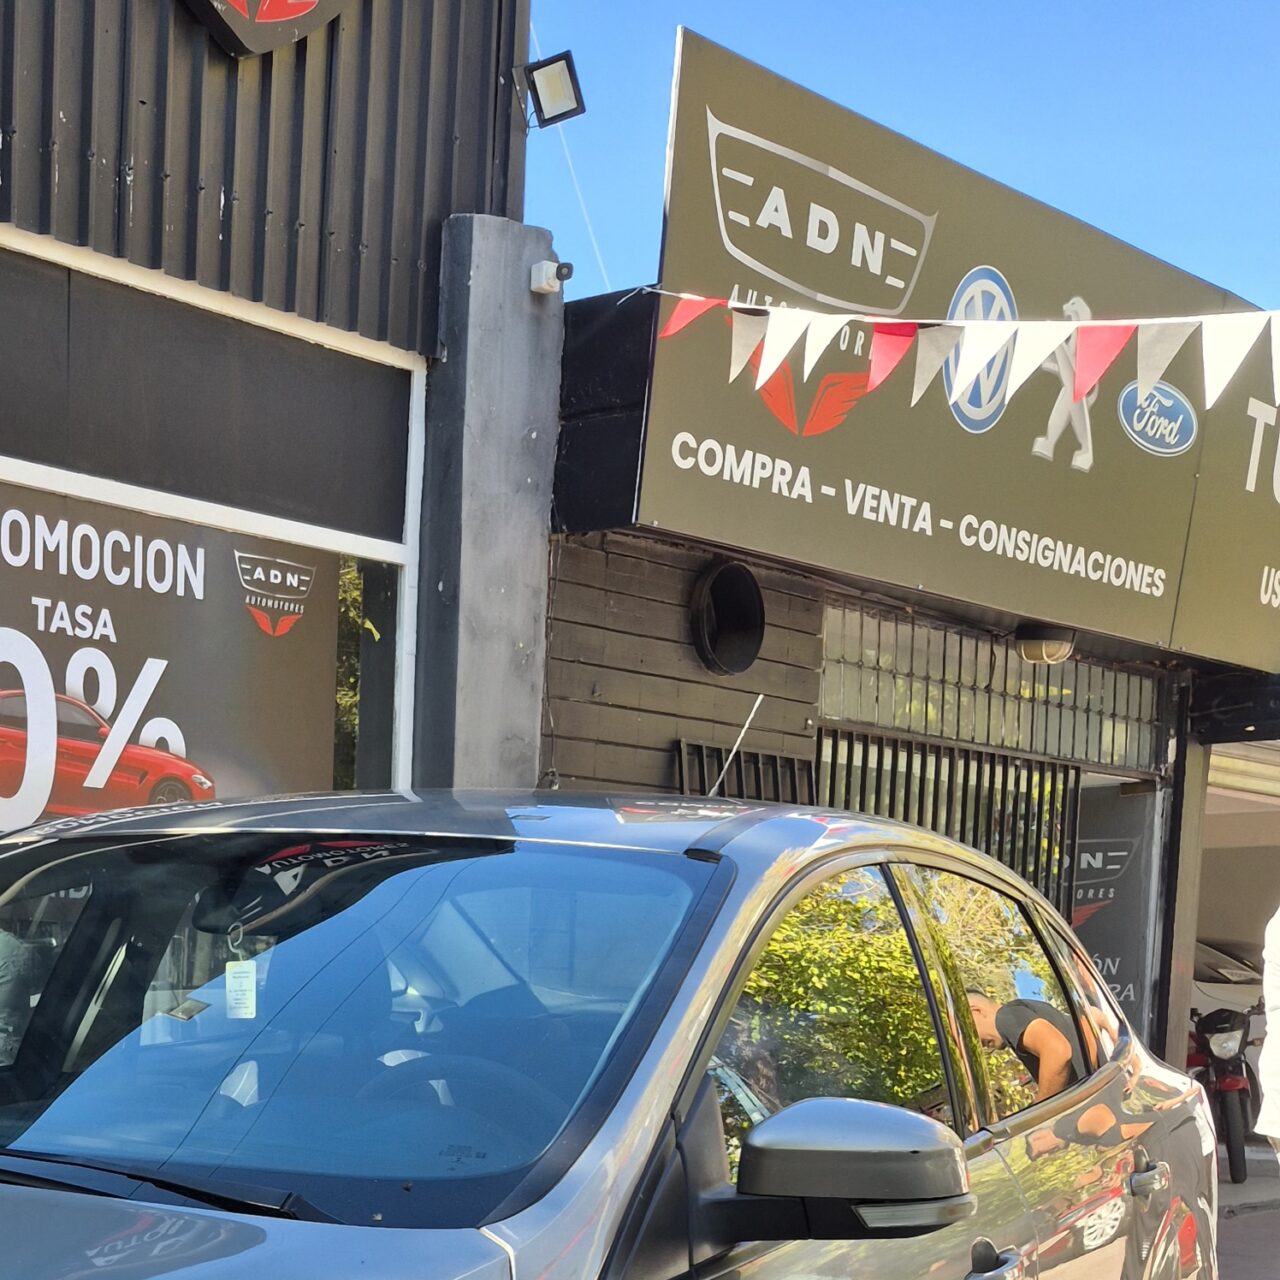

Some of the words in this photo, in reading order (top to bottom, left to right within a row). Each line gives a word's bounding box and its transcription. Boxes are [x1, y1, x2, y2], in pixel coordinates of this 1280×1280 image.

[756, 187, 884, 276] ADN
[1132, 388, 1184, 446] Ford
[671, 431, 813, 504] COMPRA
[844, 478, 933, 537] VENTA
[959, 514, 1167, 598] CONSIGNACIONES
[253, 566, 299, 589] ADN
[31, 596, 117, 643] TASA
[245, 595, 305, 614] AUTOMOTORES
